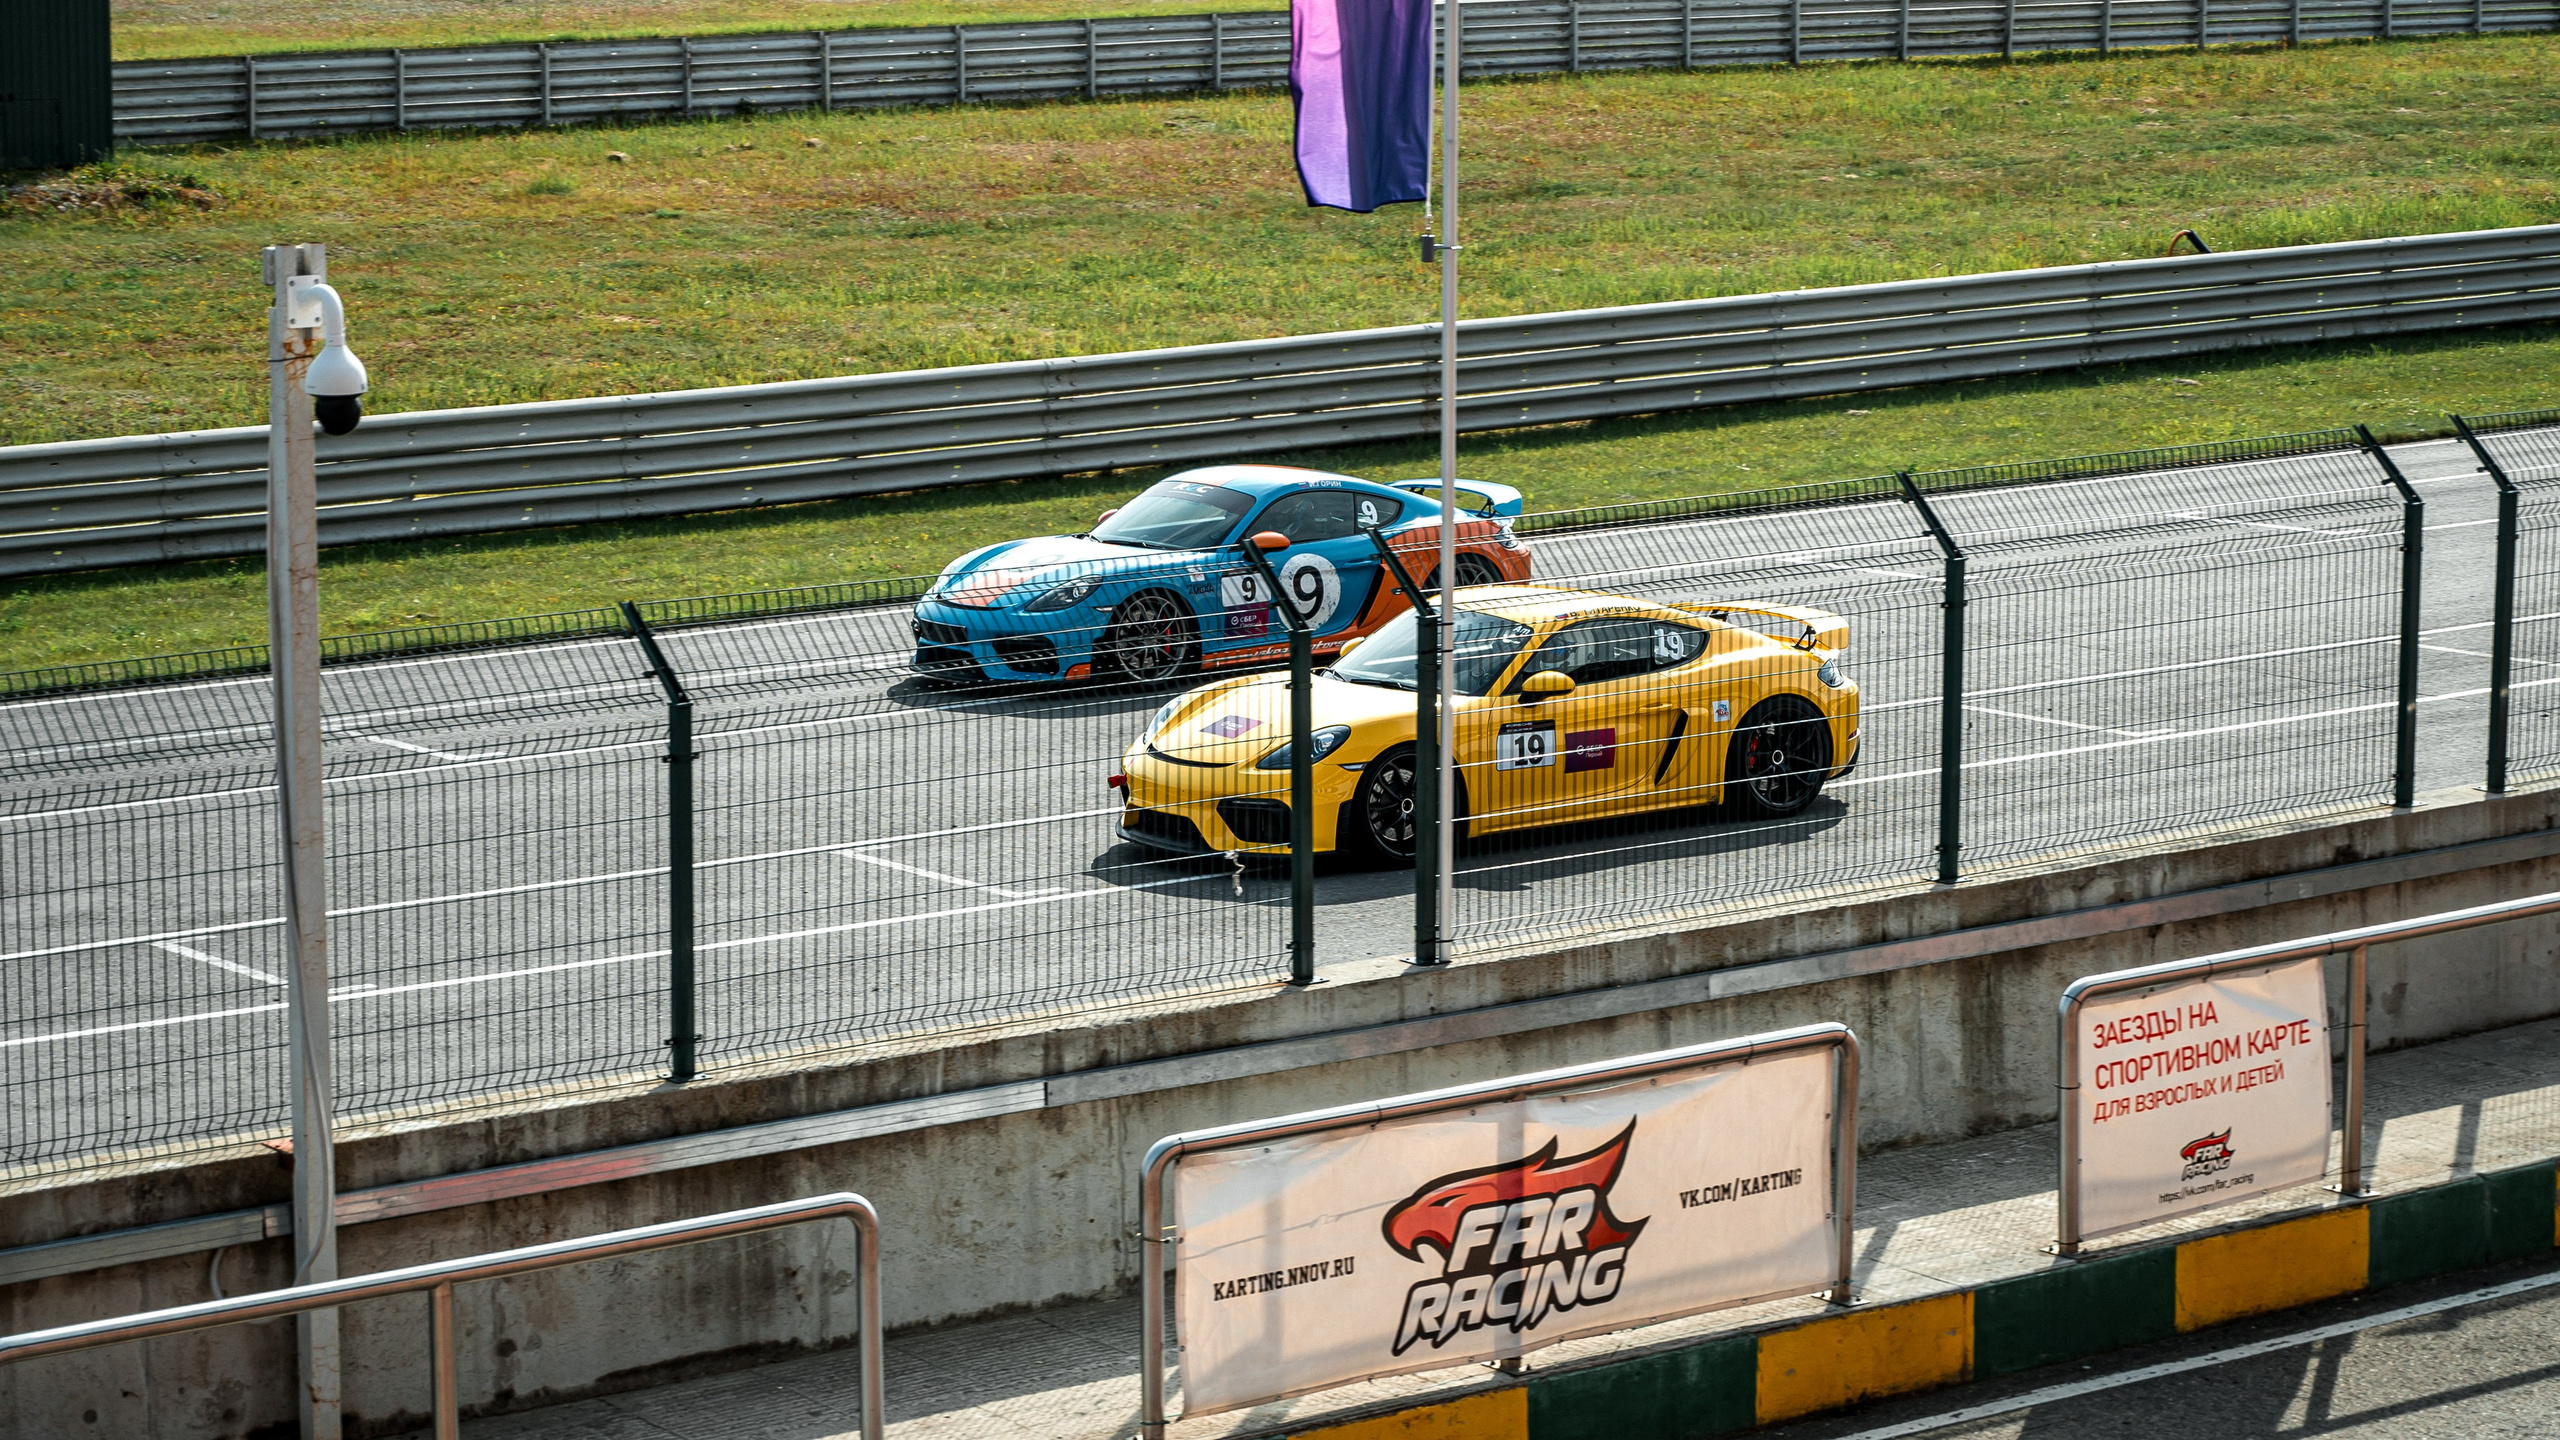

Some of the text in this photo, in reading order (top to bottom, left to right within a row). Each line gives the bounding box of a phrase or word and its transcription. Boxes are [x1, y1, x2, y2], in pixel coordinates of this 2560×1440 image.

[1361, 500, 1378, 525] 9
[1241, 576, 1257, 602] 9
[1293, 565, 1325, 622] 9
[1239, 614, 1257, 623] СБЕР
[1512, 625, 1531, 635] Am
[1654, 628, 1685, 661] 19
[1514, 734, 1546, 766] 19
[2092, 1001, 2219, 1050] ЗАЕЗДЫ НА
[2095, 1018, 2312, 1090] СПОРТИВНОМ КАРТЕ
[2093, 1058, 2285, 1124] ДЛЯ ВЗРОСЛЫХ И ДЕТЕЙ
[2181, 1156, 2231, 1181] RACING
[2193, 1143, 2223, 1163] FAR
[1679, 1168, 1803, 1209] VK.COM/KARTING
[1447, 1187, 1597, 1274] FAR
[1213, 1256, 1356, 1302] KARTING.NNOV.RU
[1395, 1247, 1623, 1350] RACING
